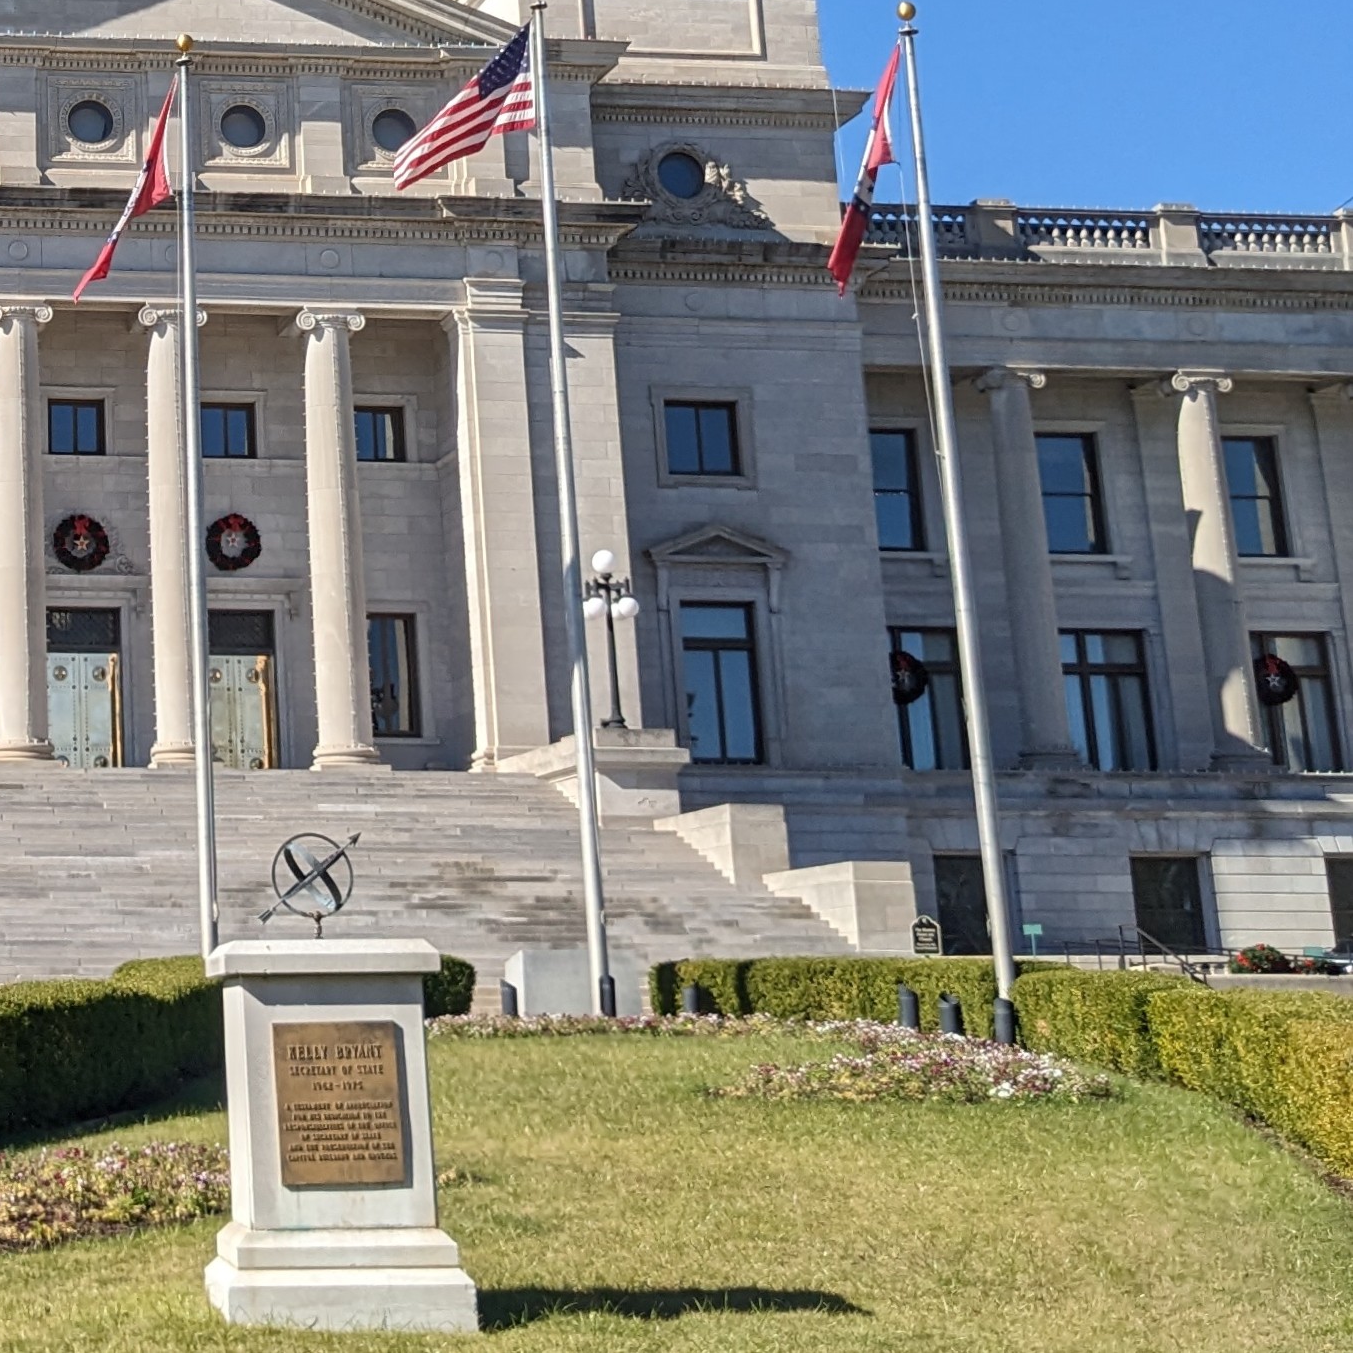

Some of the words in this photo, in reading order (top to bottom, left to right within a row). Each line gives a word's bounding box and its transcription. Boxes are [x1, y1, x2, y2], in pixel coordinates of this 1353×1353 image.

[288, 1045, 328, 1060] KELLY
[335, 1044, 382, 1059] BRYANT
[289, 1065, 336, 1076] SECRETARY
[341, 1065, 352, 1075] OF
[357, 1064, 384, 1075] STATE
